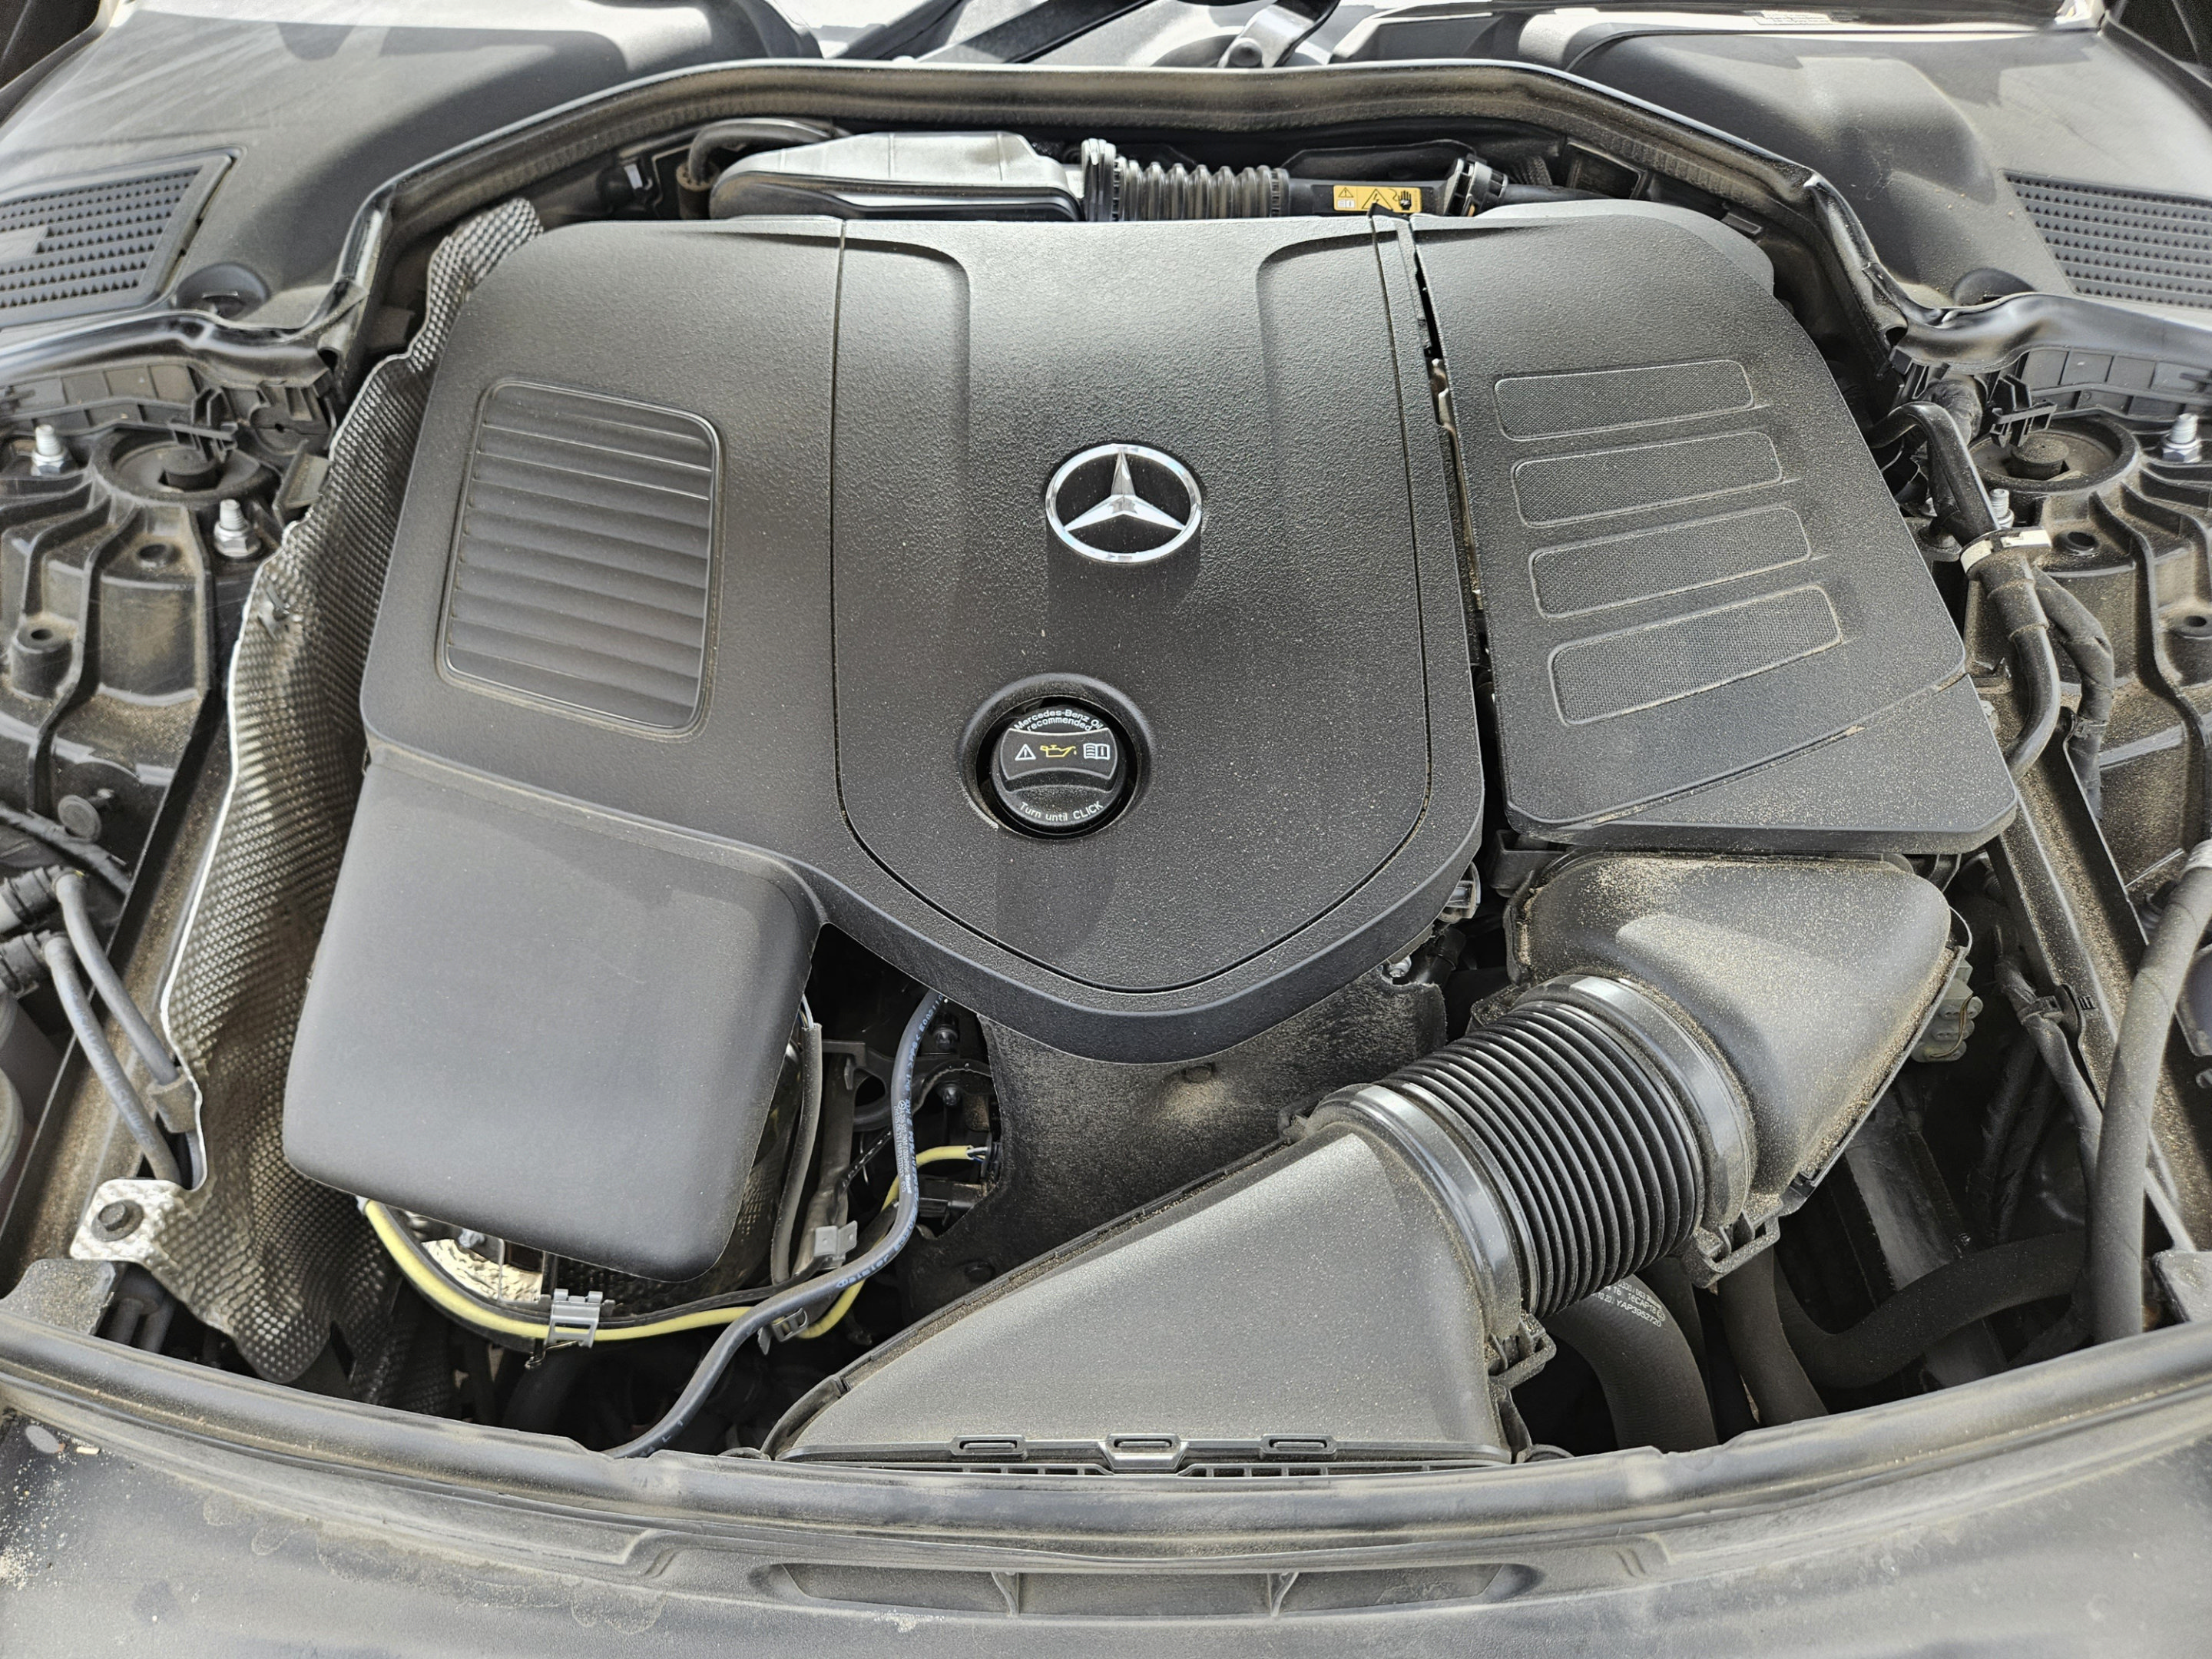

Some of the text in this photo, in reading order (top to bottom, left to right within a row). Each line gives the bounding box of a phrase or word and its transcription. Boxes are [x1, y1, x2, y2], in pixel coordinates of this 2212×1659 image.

[1014, 709, 1104, 730] Mercedes-Benz Oil
[1027, 717, 1092, 731] recommended
[1020, 801, 1103, 822] Turn until CLICK
[1616, 1299, 1662, 1327] YAP3952720
